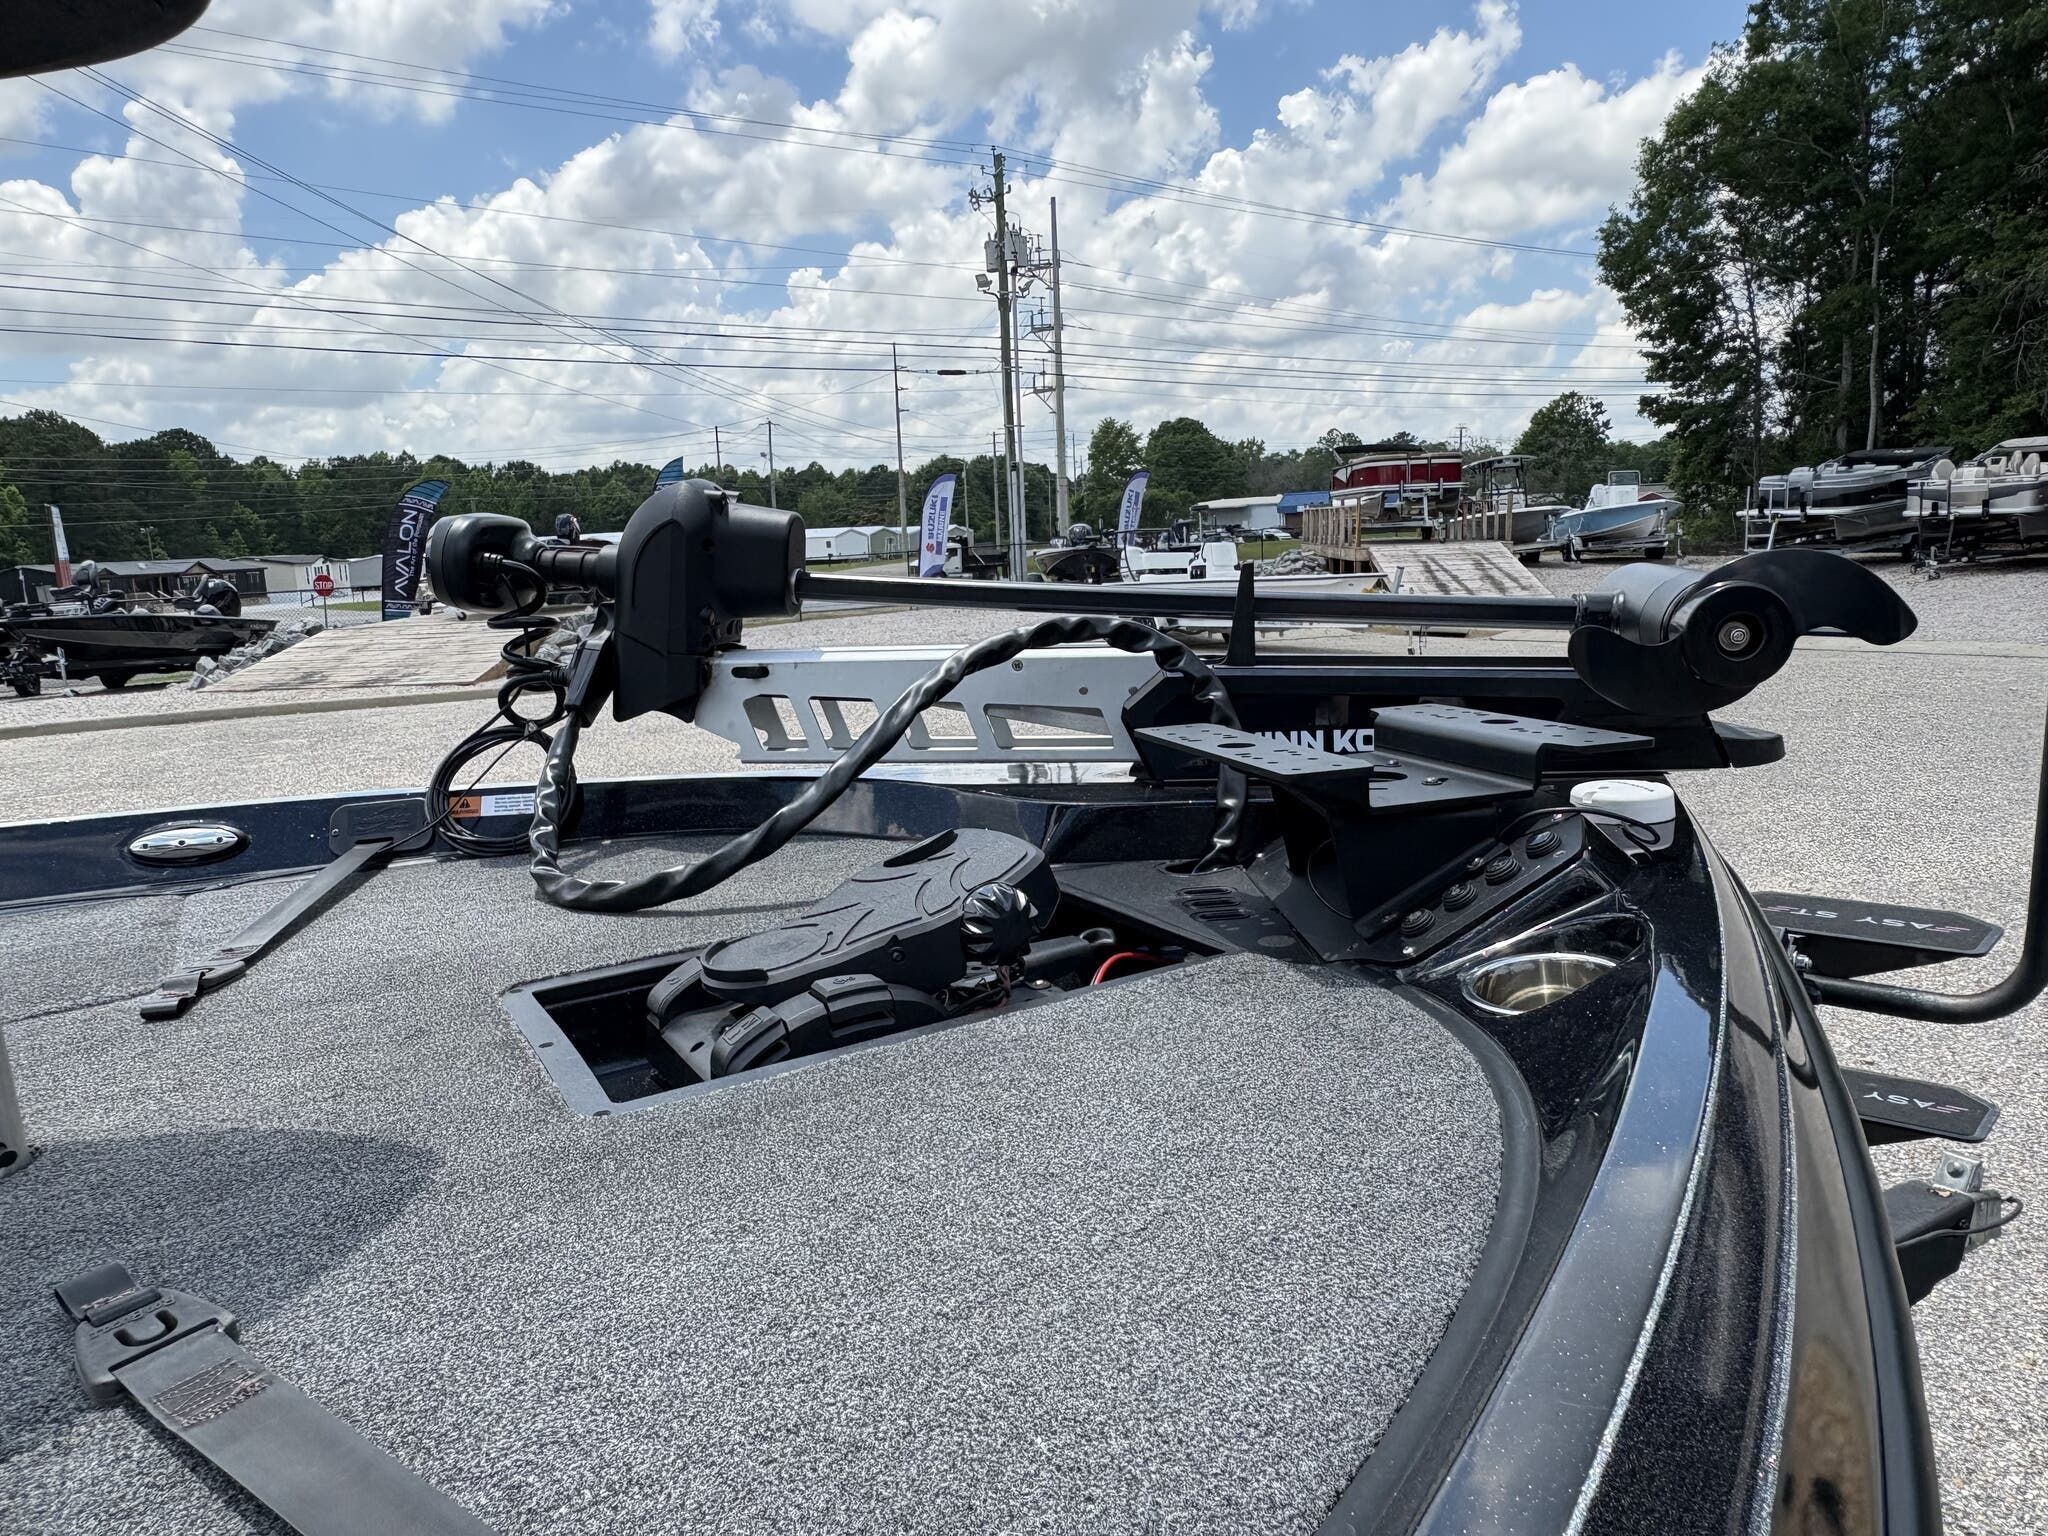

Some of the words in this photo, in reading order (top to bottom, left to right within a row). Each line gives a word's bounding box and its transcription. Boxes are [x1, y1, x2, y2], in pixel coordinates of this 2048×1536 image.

[928, 495, 939, 540] SUZUKI
[394, 509, 418, 598] AVALON
[314, 581, 333, 590] STOP
[1854, 916, 1971, 933] EASY
[1863, 1091, 1970, 1114] EASY
